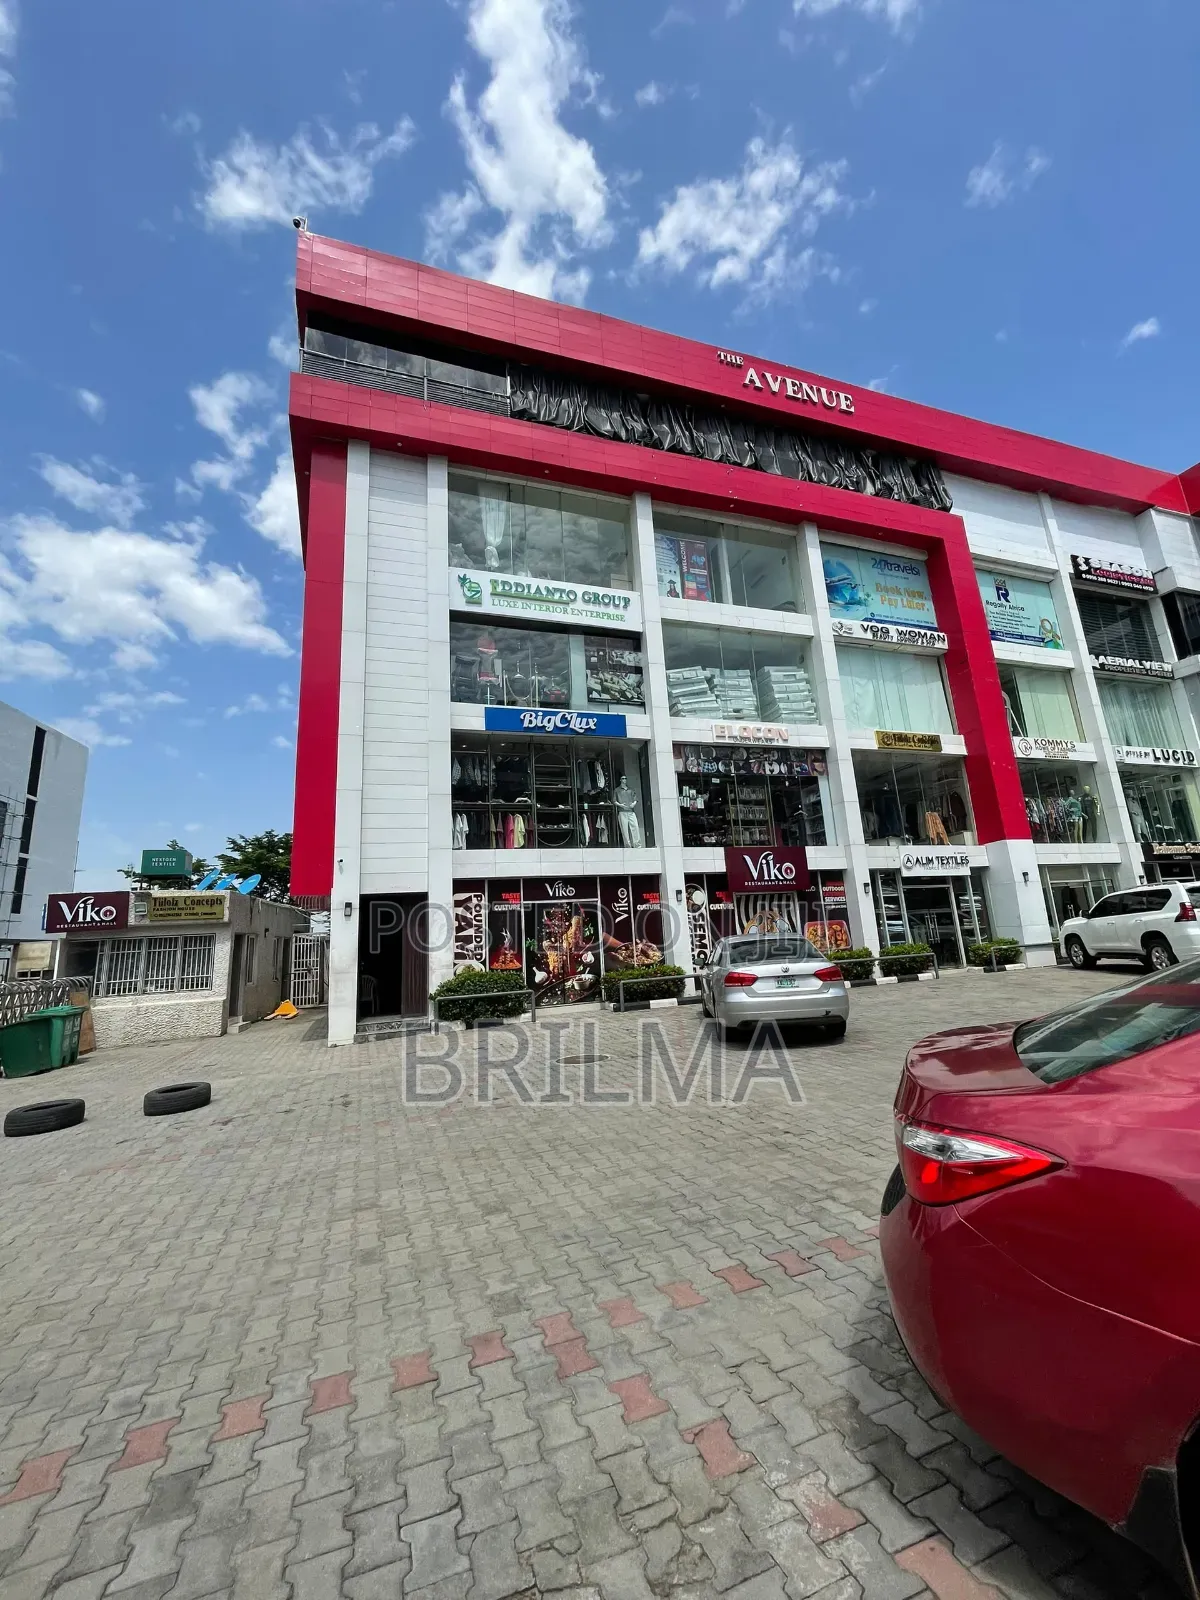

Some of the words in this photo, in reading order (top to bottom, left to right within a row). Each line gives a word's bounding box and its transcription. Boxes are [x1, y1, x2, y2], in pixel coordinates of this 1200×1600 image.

[718, 351, 744, 366] THE
[743, 367, 855, 414] AVENUE
[680, 541, 688, 572] WELCOME
[1089, 558, 1154, 580] SEASON
[582, 591, 631, 610] GROUP
[880, 595, 898, 609] Pay
[492, 599, 520, 609] LUXE
[521, 603, 568, 616] INTERIOR
[570, 608, 626, 622] ENTERPRISE
[861, 624, 890, 635] VOG
[896, 628, 946, 643] WOMAN
[1033, 738, 1076, 749] KOMMYS
[1152, 749, 1195, 763] LUCID
[743, 851, 796, 880] Viko
[915, 856, 935, 865] ALIM
[935, 855, 970, 866] TEXTILES
[544, 880, 576, 897] Viko
[58, 896, 117, 923] Viko
[184, 897, 223, 908] Concepts
[612, 888, 629, 924] Viko
[473, 894, 483, 962] POUNDED
